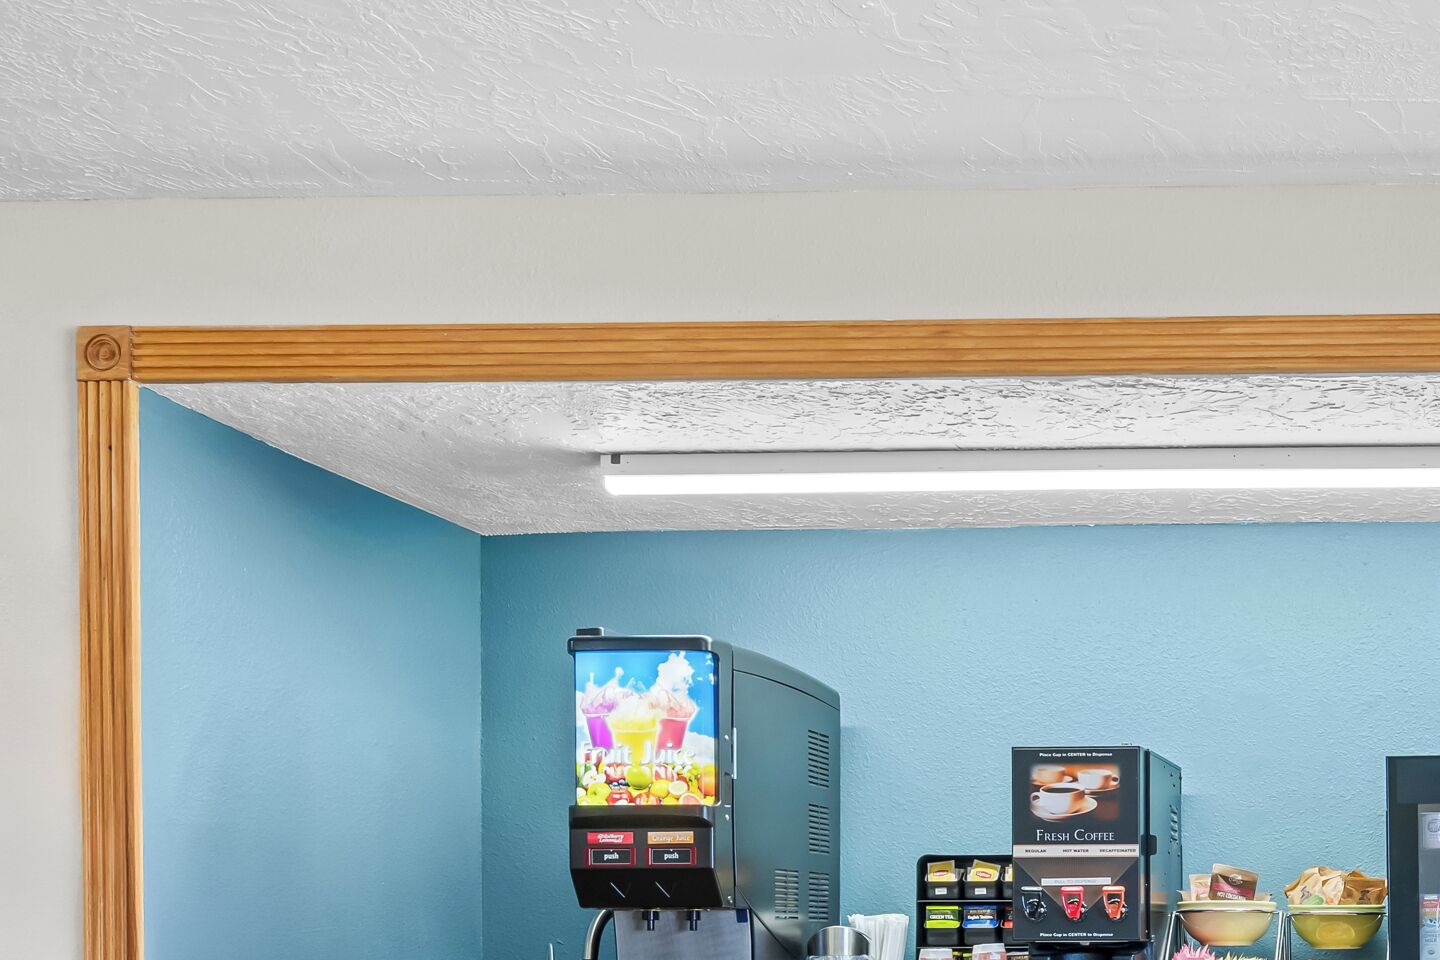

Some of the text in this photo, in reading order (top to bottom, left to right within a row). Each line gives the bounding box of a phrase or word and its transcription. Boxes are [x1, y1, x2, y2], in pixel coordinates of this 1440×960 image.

[580, 740, 696, 765] Fruit Juice
[1036, 829, 1115, 841] FRESH COFFEE
[603, 852, 620, 861] push
[663, 852, 680, 861] push
